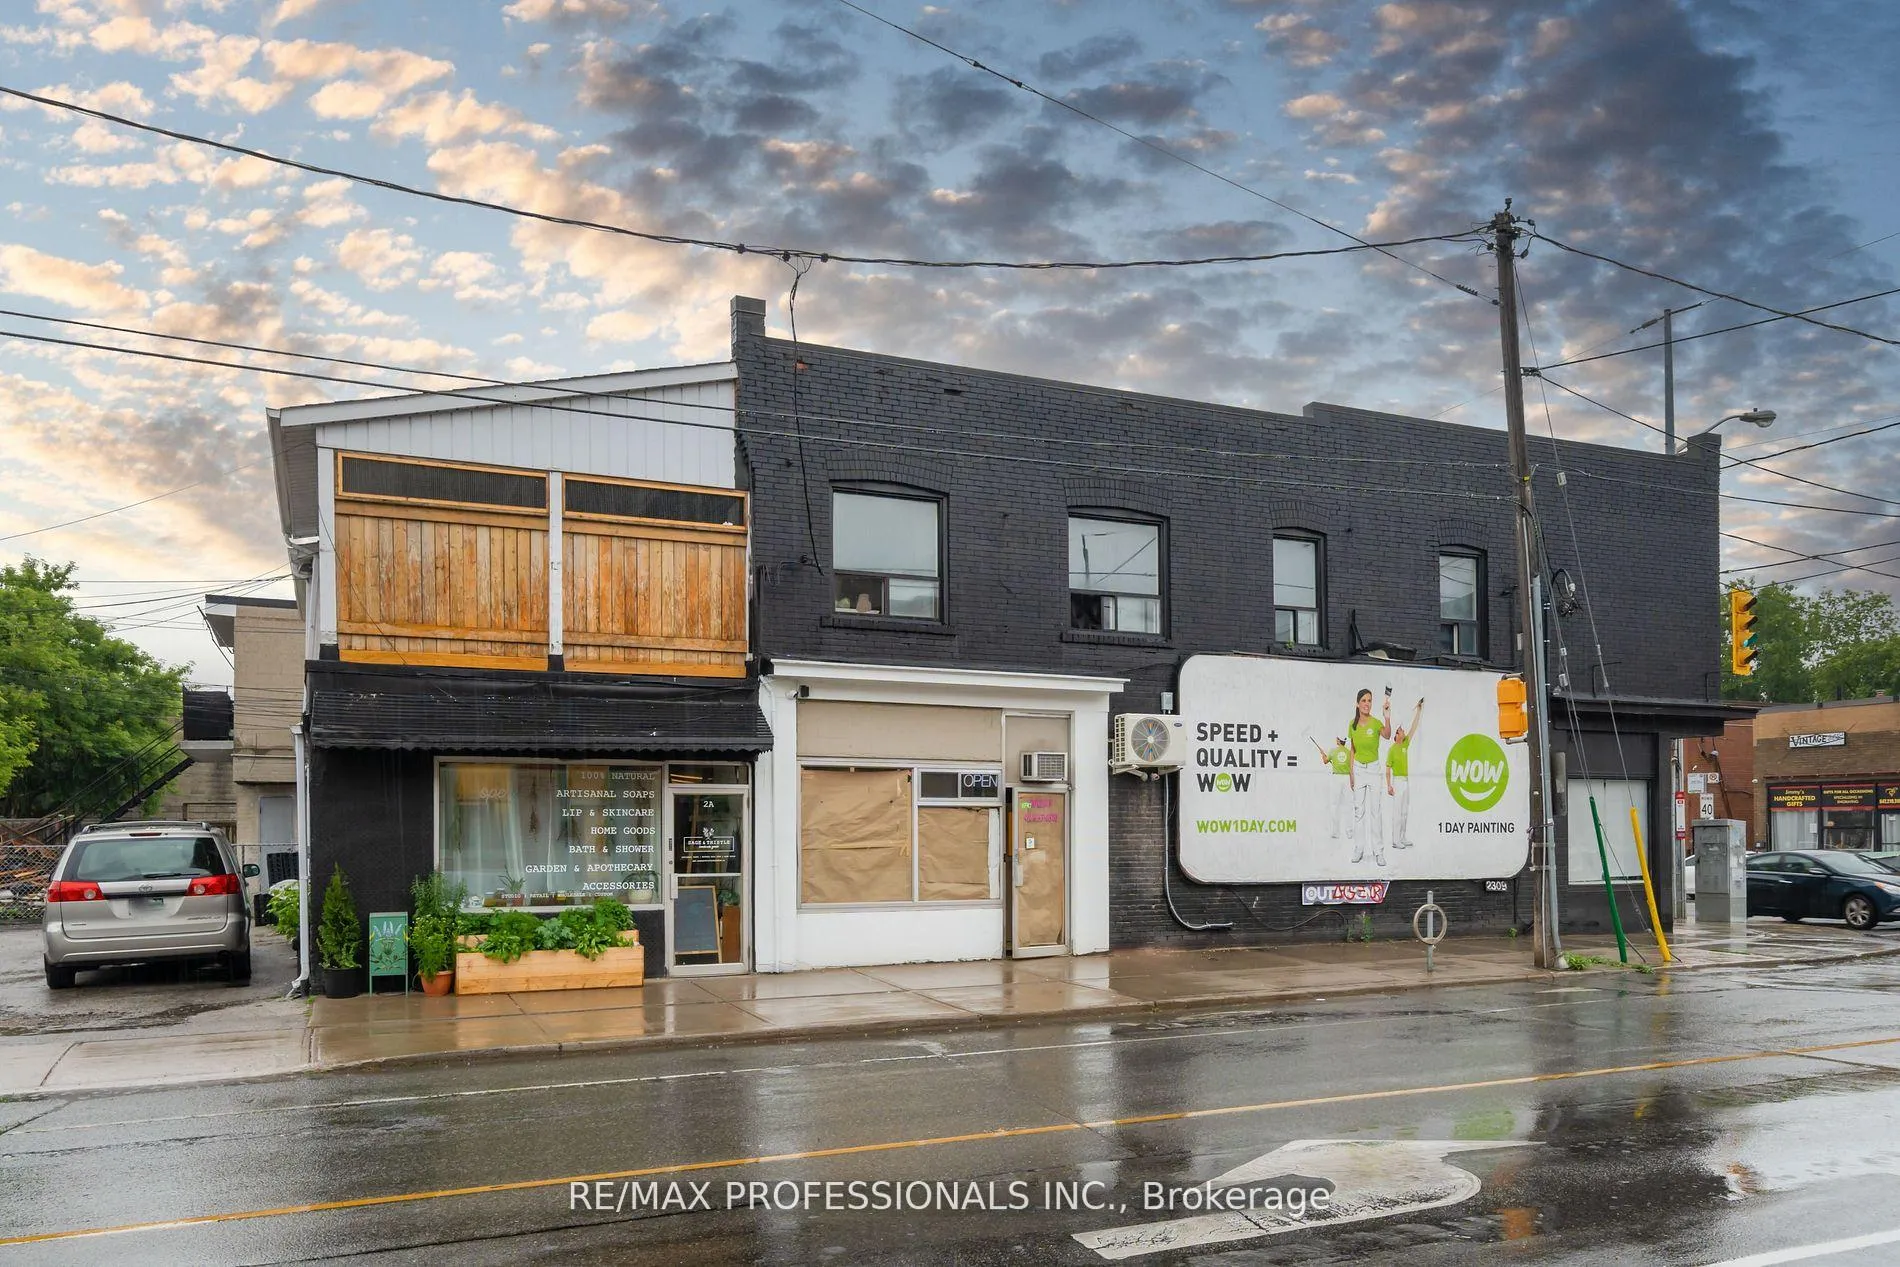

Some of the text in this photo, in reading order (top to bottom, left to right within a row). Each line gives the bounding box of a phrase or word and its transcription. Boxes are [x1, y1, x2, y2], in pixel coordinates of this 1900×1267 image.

[1196, 722, 1262, 743] SPEED
[1791, 735, 1827, 747] VINTAGE
[1196, 748, 1282, 768] QUALITY
[580, 771, 655, 780] 100% NATURAL
[1451, 759, 1504, 784] WOW
[963, 774, 998, 788] OPEN
[1197, 773, 1251, 792] WOW
[556, 789, 655, 799] ARTISANAL SOAPS
[703, 800, 715, 808] 2A
[1702, 804, 1713, 815] 40
[562, 808, 583, 817] LIP
[602, 808, 655, 817] SKINCARE
[591, 827, 656, 835] HOME GOODS
[1197, 819, 1297, 833] WOW1DAY.COM
[1445, 822, 1465, 833] DAY
[1468, 822, 1515, 834] PAINTING
[569, 845, 655, 854] BATH & SHOWER
[525, 863, 654, 874] GARDEN & APOTHECARY
[583, 881, 655, 890] ACCESSORIES
